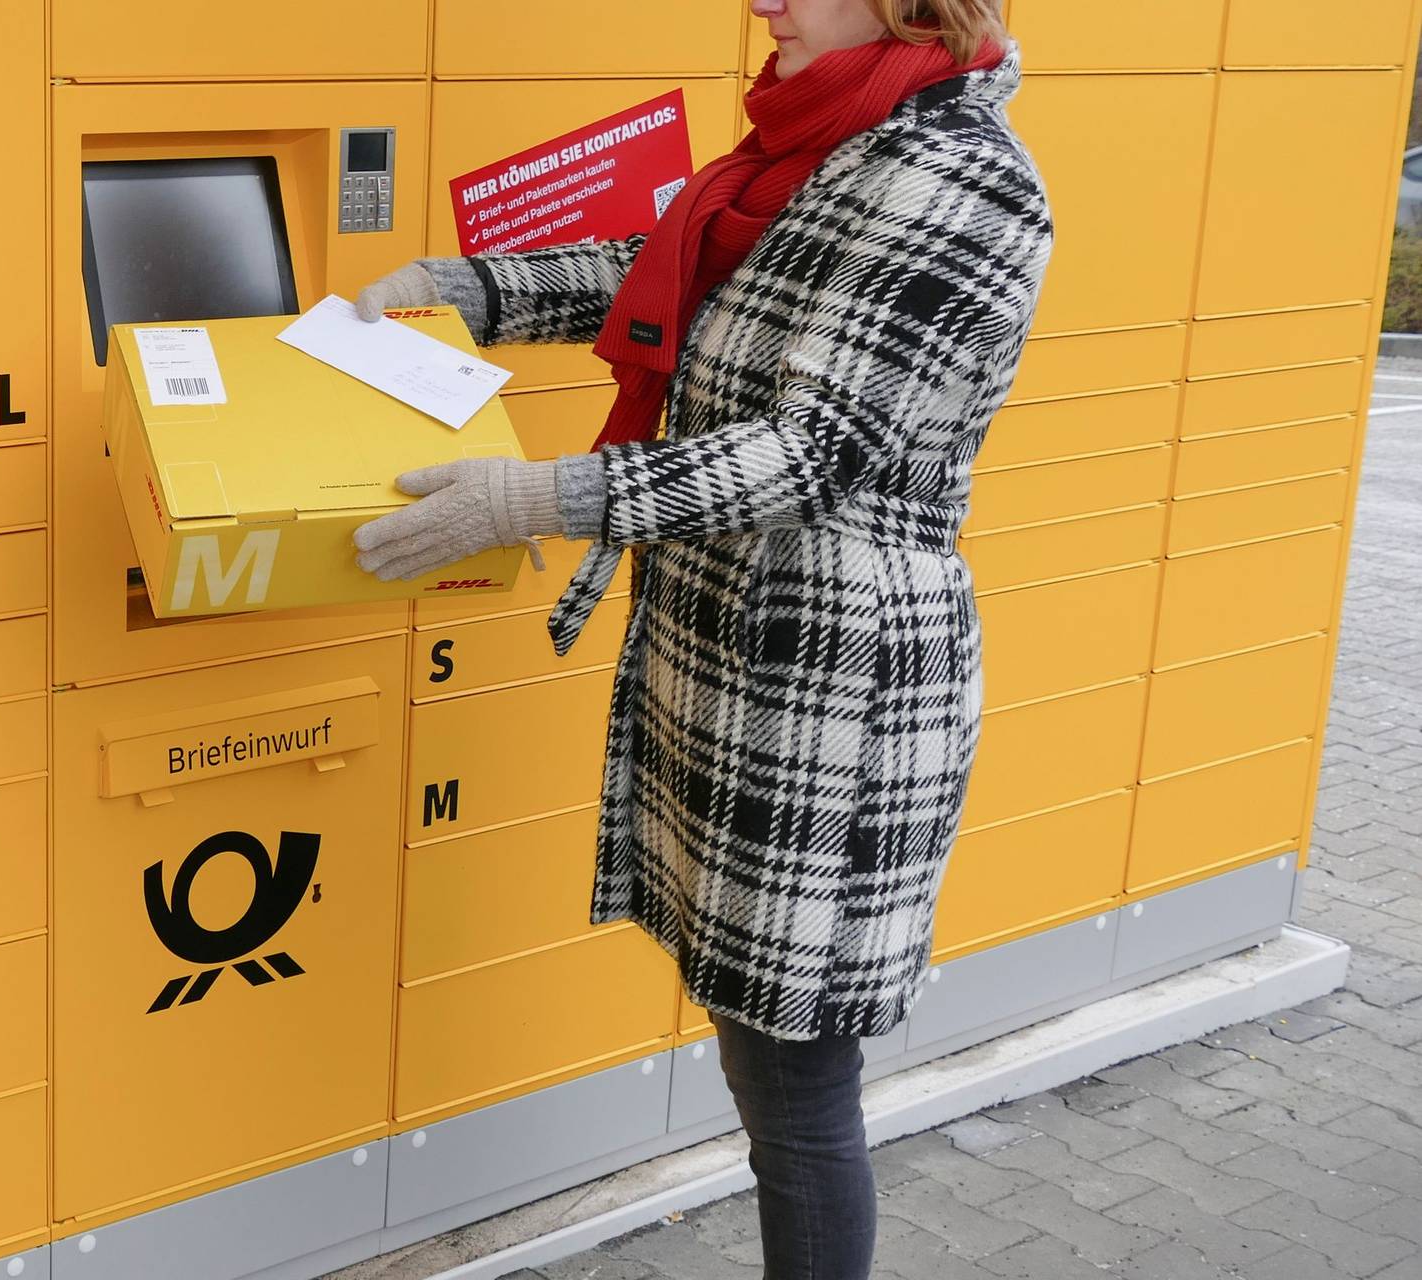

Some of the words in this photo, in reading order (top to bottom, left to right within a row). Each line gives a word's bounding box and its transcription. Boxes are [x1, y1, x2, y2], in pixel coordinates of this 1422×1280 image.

[462, 178, 498, 206] HIER
[499, 152, 559, 191] KÖNNEN
[561, 144, 583, 167] SIE
[584, 106, 677, 157] KONTAKTLOS:
[479, 204, 505, 222] Brief-
[507, 193, 525, 211] und
[526, 171, 584, 202] Paketmarken
[585, 157, 616, 177] kaufen
[482, 220, 510, 240] Briefe
[512, 210, 529, 227] und
[530, 198, 561, 220] Pakete
[562, 177, 613, 207] verschicken
[552, 209, 583, 230] nutzen
[382, 309, 438, 319] DHL
[169, 529, 281, 611] M
[435, 578, 492, 590] DHL
[429, 639, 454, 683] S
[168, 717, 332, 774] Briefeinwurf
[423, 779, 459, 827] M
